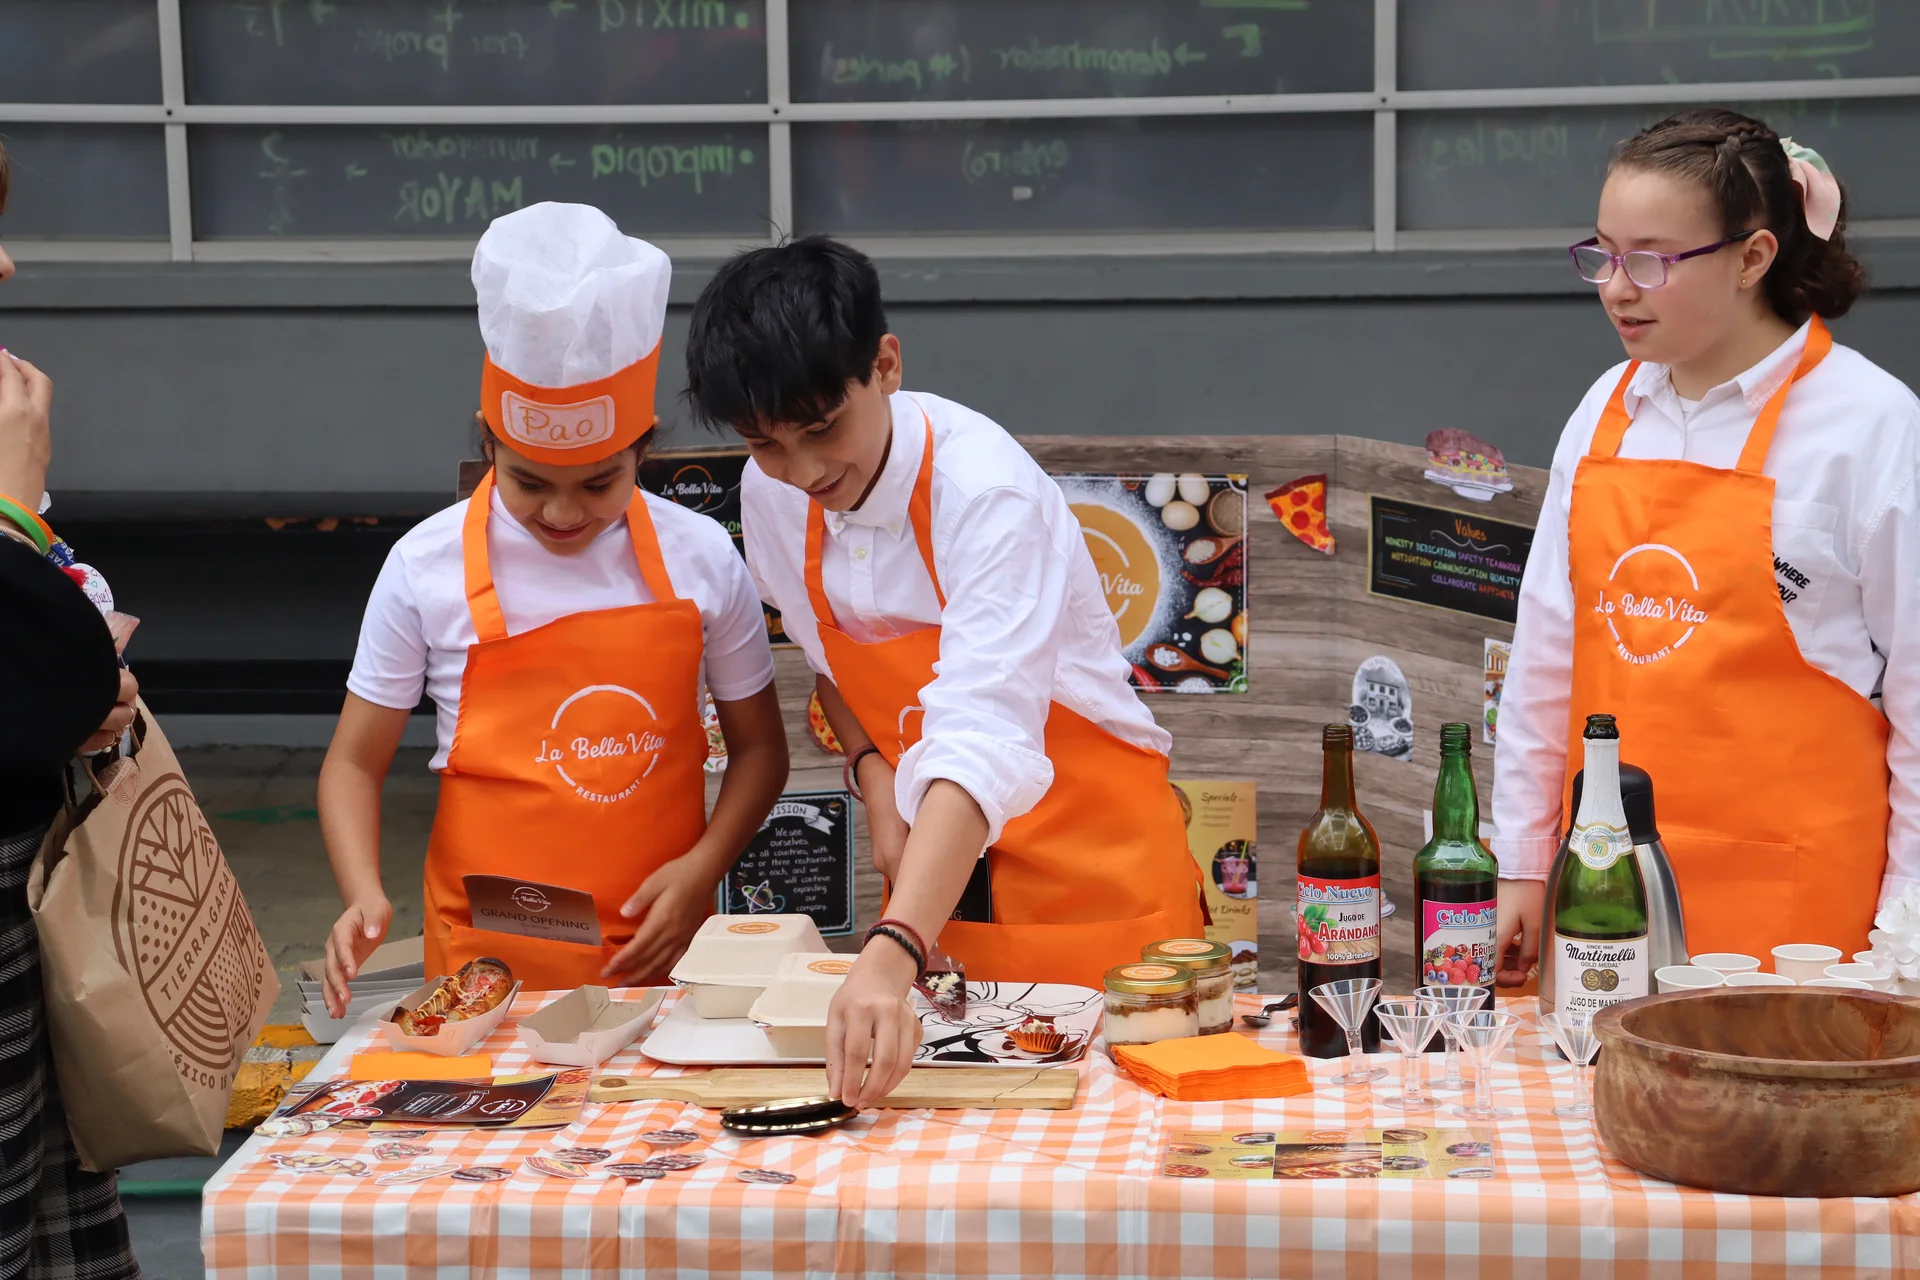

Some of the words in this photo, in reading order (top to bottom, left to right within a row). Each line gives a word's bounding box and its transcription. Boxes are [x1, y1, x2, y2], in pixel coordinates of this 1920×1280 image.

[519, 406, 593, 441] Pao
[660, 484, 674, 496] La
[676, 482, 702, 495] Bella
[702, 481, 723, 494] Vita
[1455, 519, 1487, 541] Values
[1458, 551, 1484, 565] SAFETY
[1100, 573, 1144, 595] Vita
[1594, 591, 1615, 613] La
[1621, 593, 1665, 619] Bella
[1665, 597, 1708, 623] Vita
[1617, 642, 1671, 664] RESTAURANT
[535, 740, 564, 763] La
[570, 737, 627, 760] Bella
[626, 731, 665, 753] Vita
[575, 778, 641, 803] RESTAURANT
[770, 838, 808, 847] ourselves
[1326, 885, 1373, 900] Nuevo
[481, 908, 527, 922] GRAND
[530, 915, 590, 931] OPENING
[1437, 909, 1476, 925] Cielo
[1570, 996, 1586, 1007] JUGO
[1588, 999, 1597, 1008] DE
